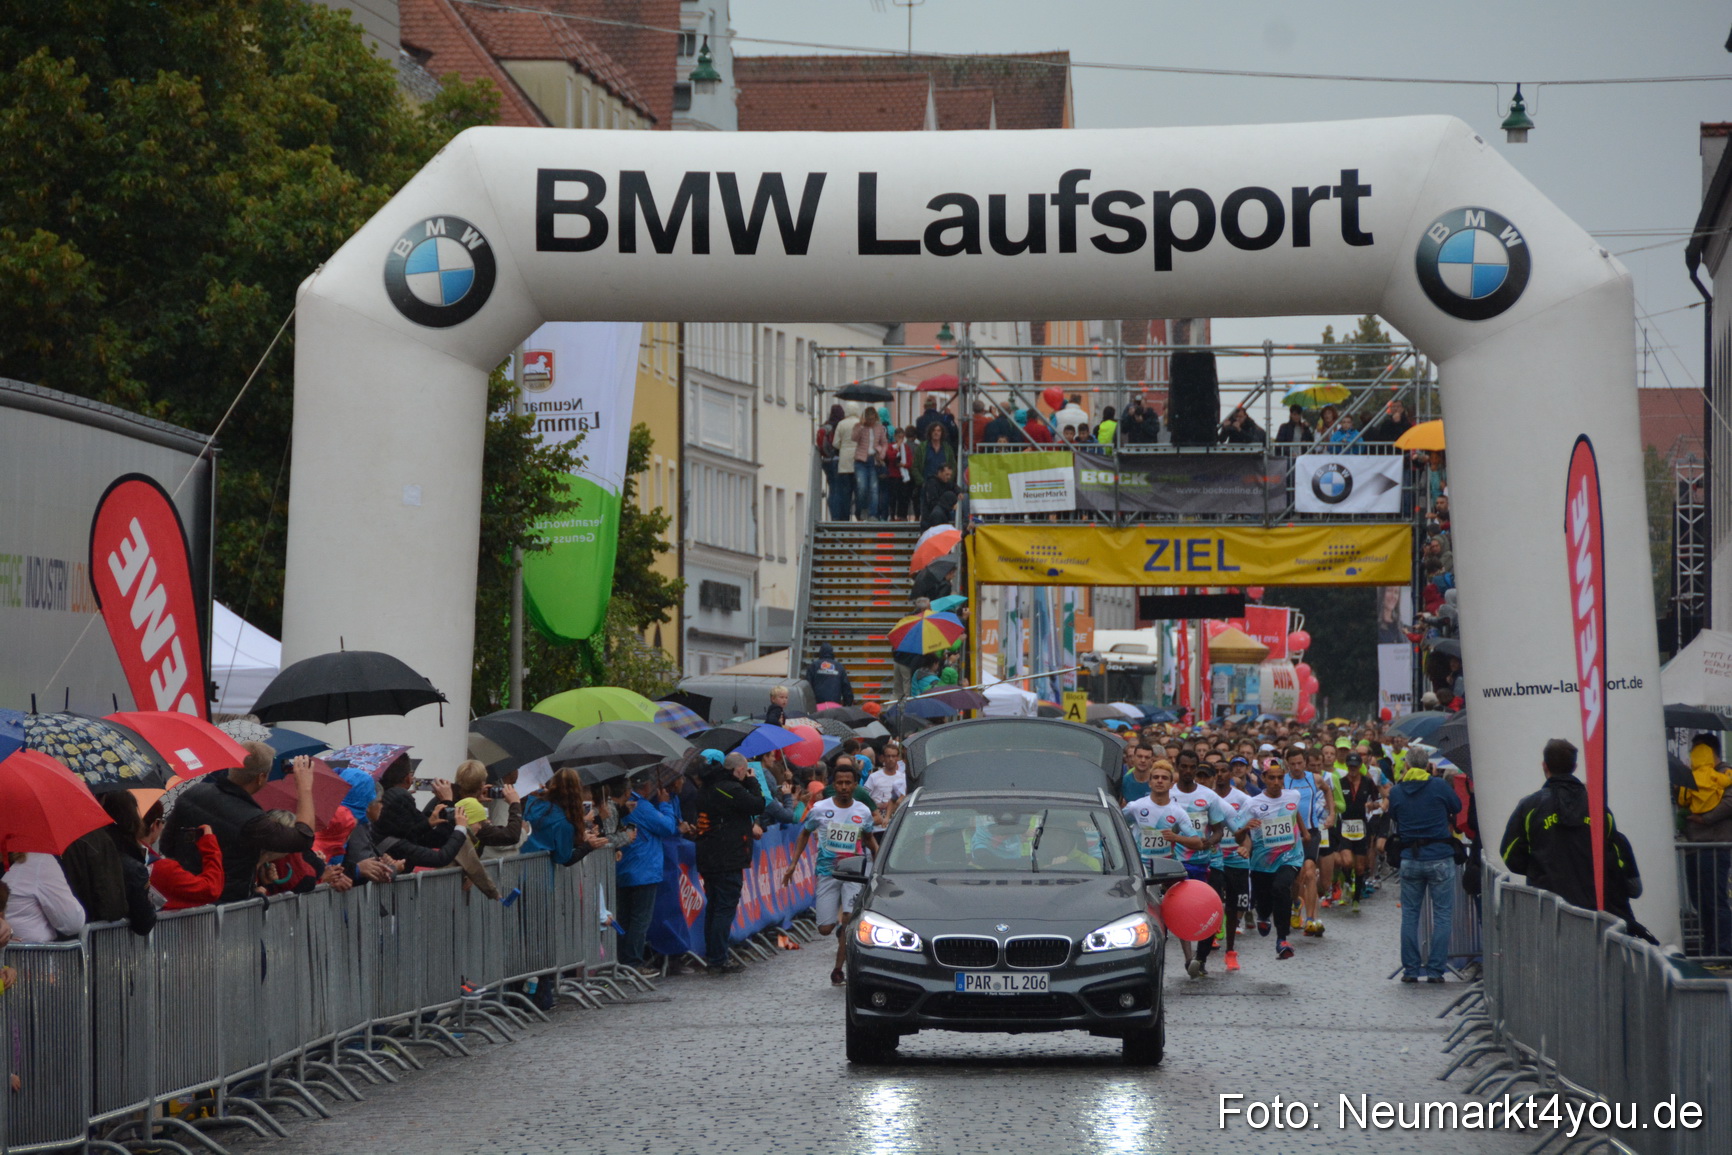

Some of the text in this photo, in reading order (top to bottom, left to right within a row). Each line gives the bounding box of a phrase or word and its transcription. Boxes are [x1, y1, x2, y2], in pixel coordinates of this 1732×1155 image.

[535, 168, 1375, 272] BMW Laufsport
[1426, 208, 1524, 249] BMW
[392, 216, 485, 260] BMW
[1315, 463, 1351, 479] BMW
[1022, 490, 1068, 499] NeuerMarkt
[1143, 538, 1241, 572] ZIEL
[25, 555, 70, 612] INDUSTRY
[108, 516, 199, 719] EWE
[1571, 474, 1602, 741] REWE
[1273, 667, 1295, 690] AVIA
[1066, 693, 1085, 701] Block
[1067, 703, 1081, 720] A
[829, 828, 856, 843] 2678
[1265, 822, 1291, 837] 2736
[966, 975, 991, 990] PAR
[1002, 975, 1019, 990] TL
[1022, 975, 1047, 990] 206
